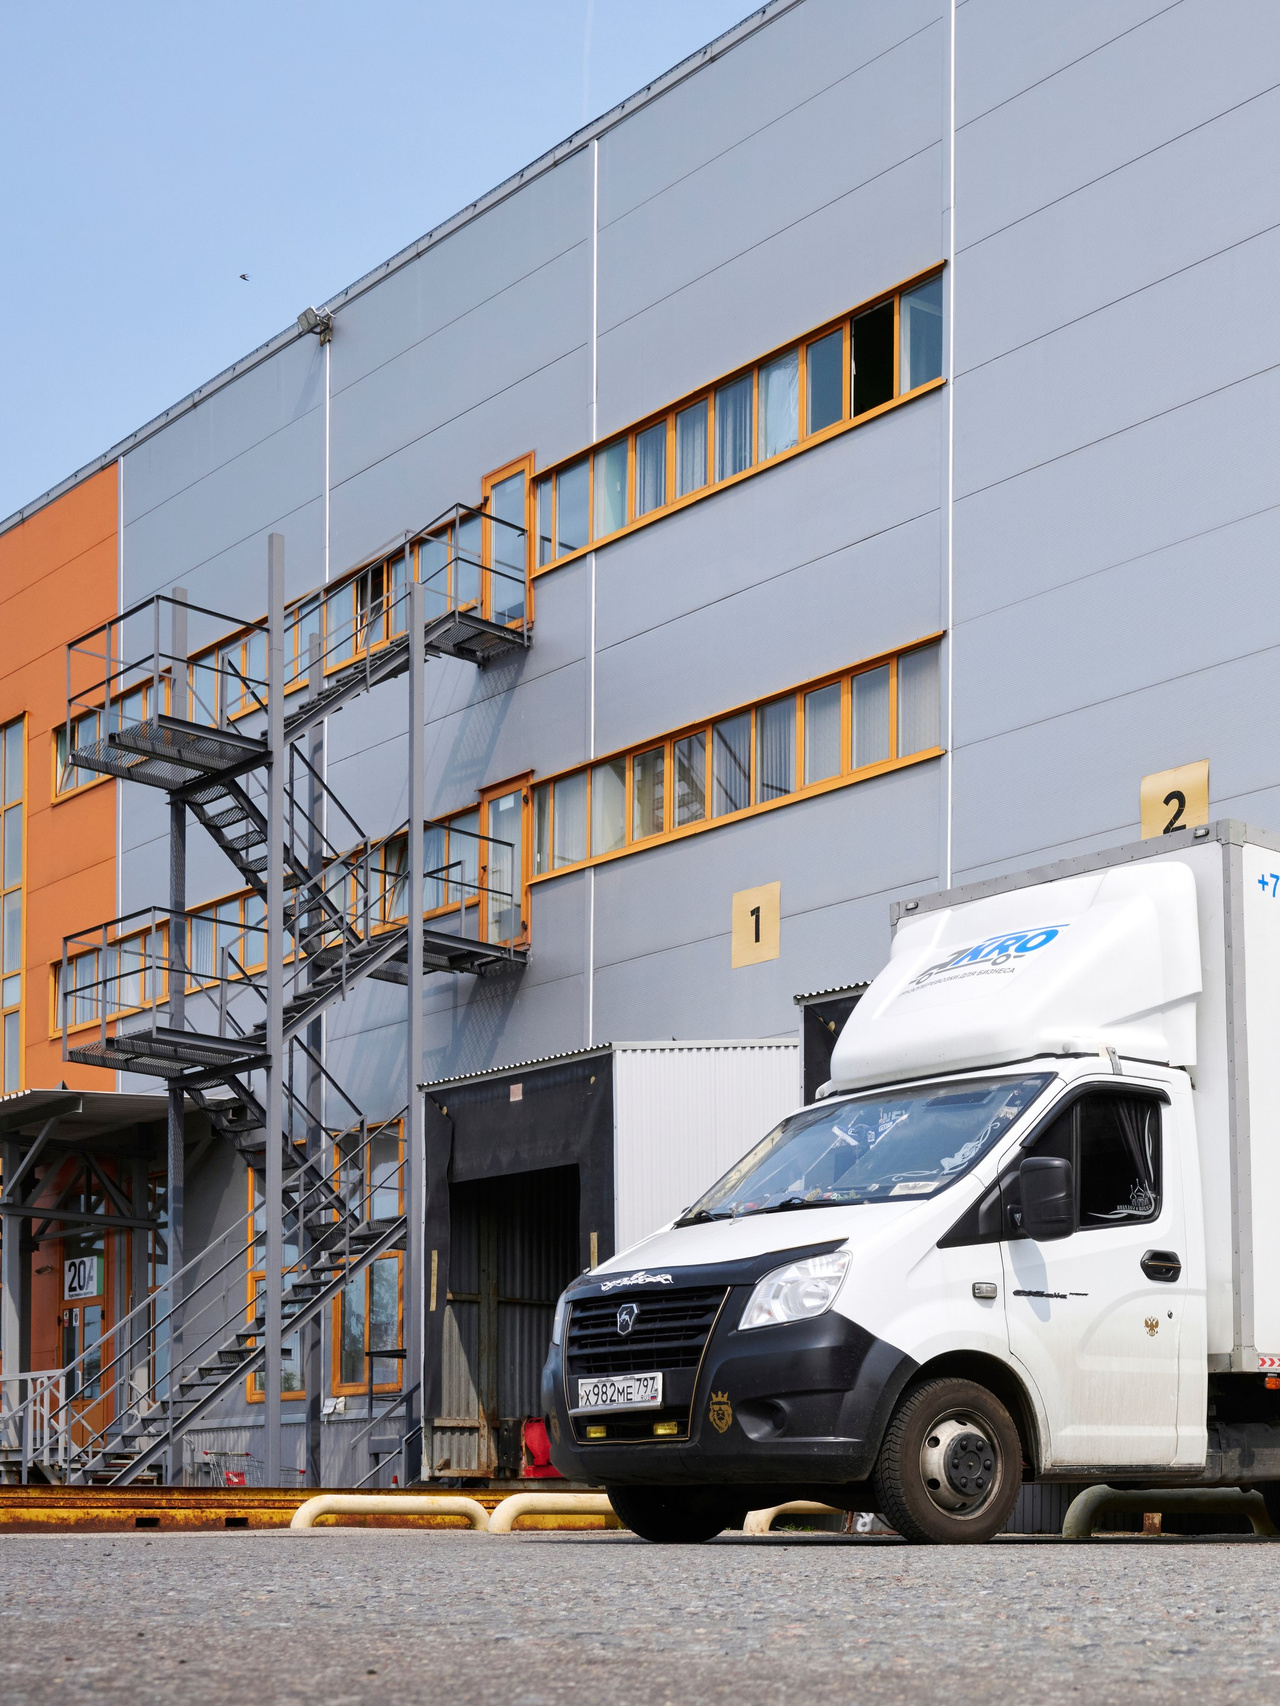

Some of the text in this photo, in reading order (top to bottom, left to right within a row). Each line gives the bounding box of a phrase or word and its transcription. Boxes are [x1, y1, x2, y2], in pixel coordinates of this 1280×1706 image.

[1162, 790, 1186, 835] 2
[1257, 873, 1280, 898] +7
[750, 905, 760, 943] 1
[636, 1377, 656, 1395] 797
